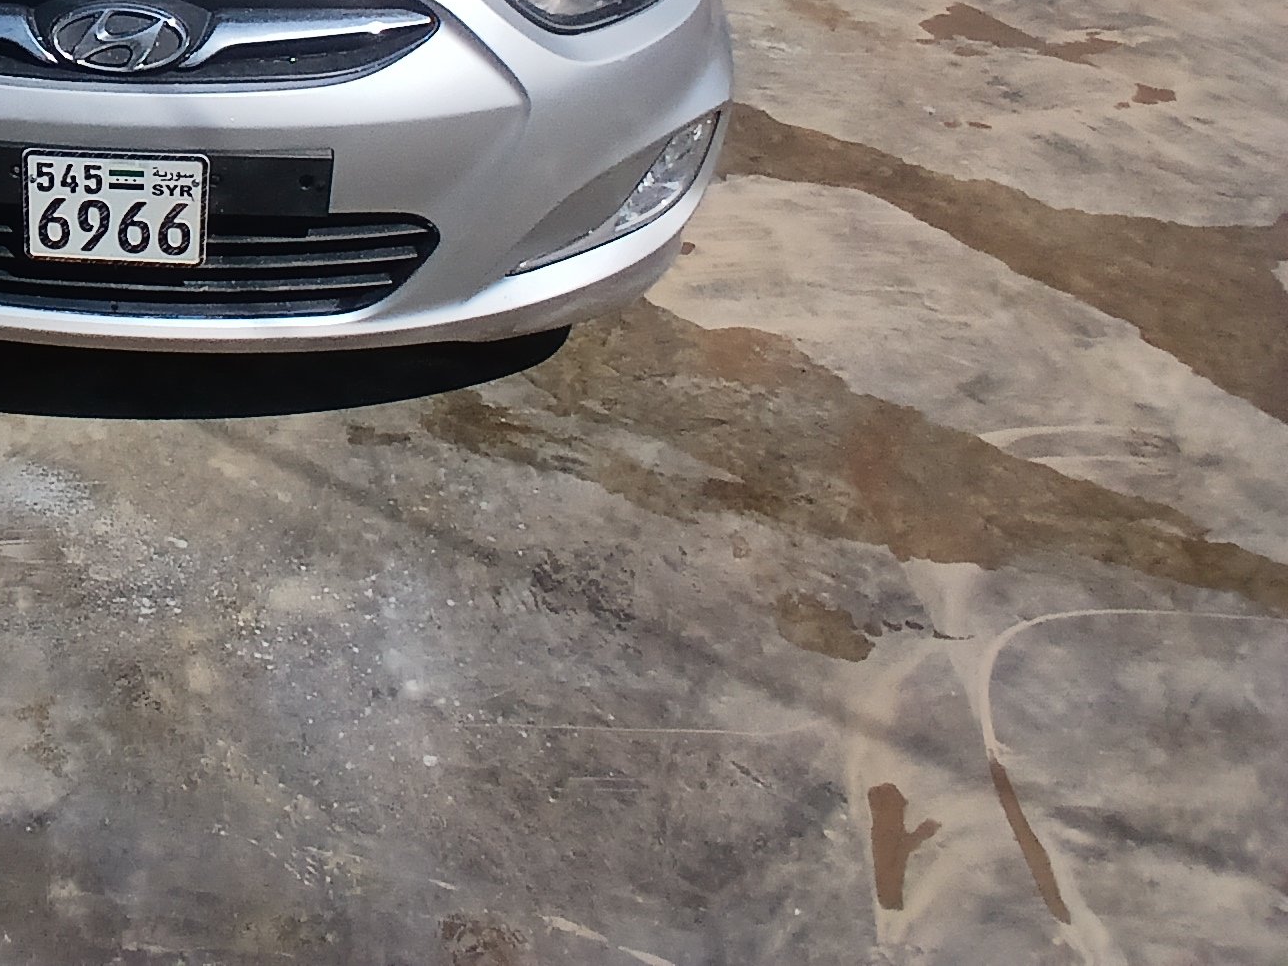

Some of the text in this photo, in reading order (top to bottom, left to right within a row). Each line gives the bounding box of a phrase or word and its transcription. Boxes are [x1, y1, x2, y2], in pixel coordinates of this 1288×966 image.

[35, 162, 103, 194] 545
[152, 166, 195, 183] سورية
[151, 183, 193, 199] SYR
[38, 197, 192, 257] 6966
